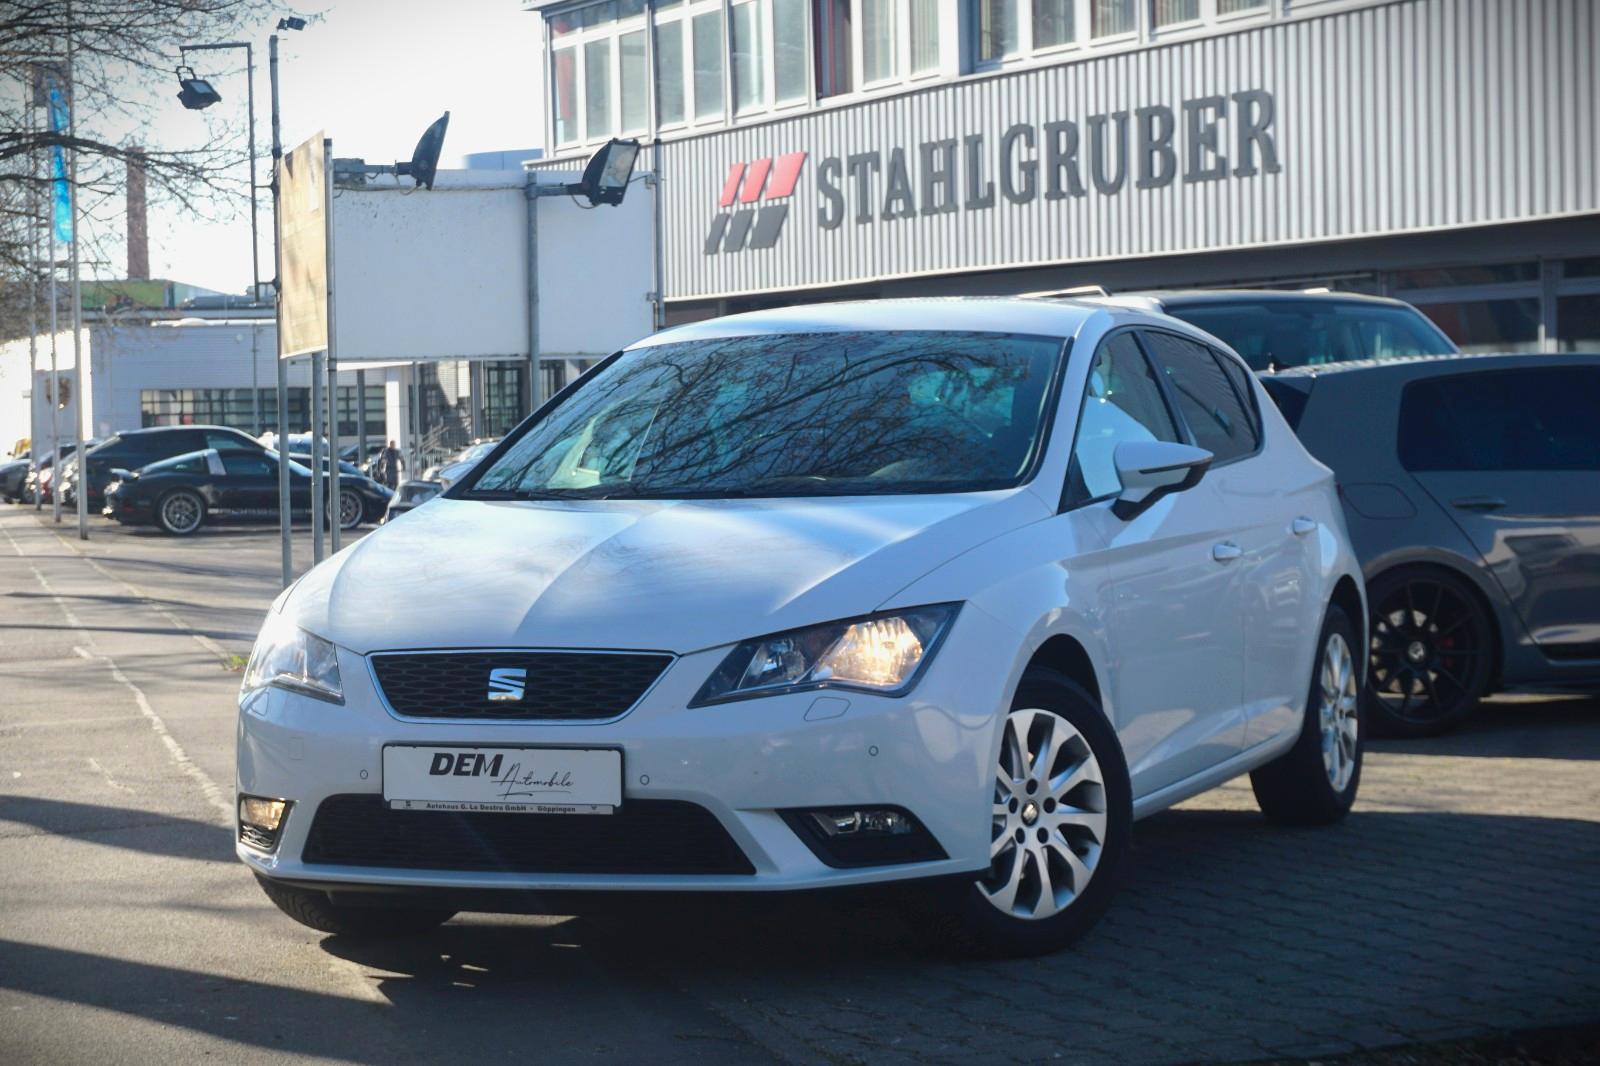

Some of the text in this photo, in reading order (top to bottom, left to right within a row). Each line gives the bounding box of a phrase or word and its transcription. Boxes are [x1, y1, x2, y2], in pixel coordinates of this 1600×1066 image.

[816, 88, 1281, 231] STAHLGRUBER
[429, 752, 574, 799] DEM Automobile
[426, 802, 459, 810] Autohaus
[537, 805, 576, 814] Göppingen
